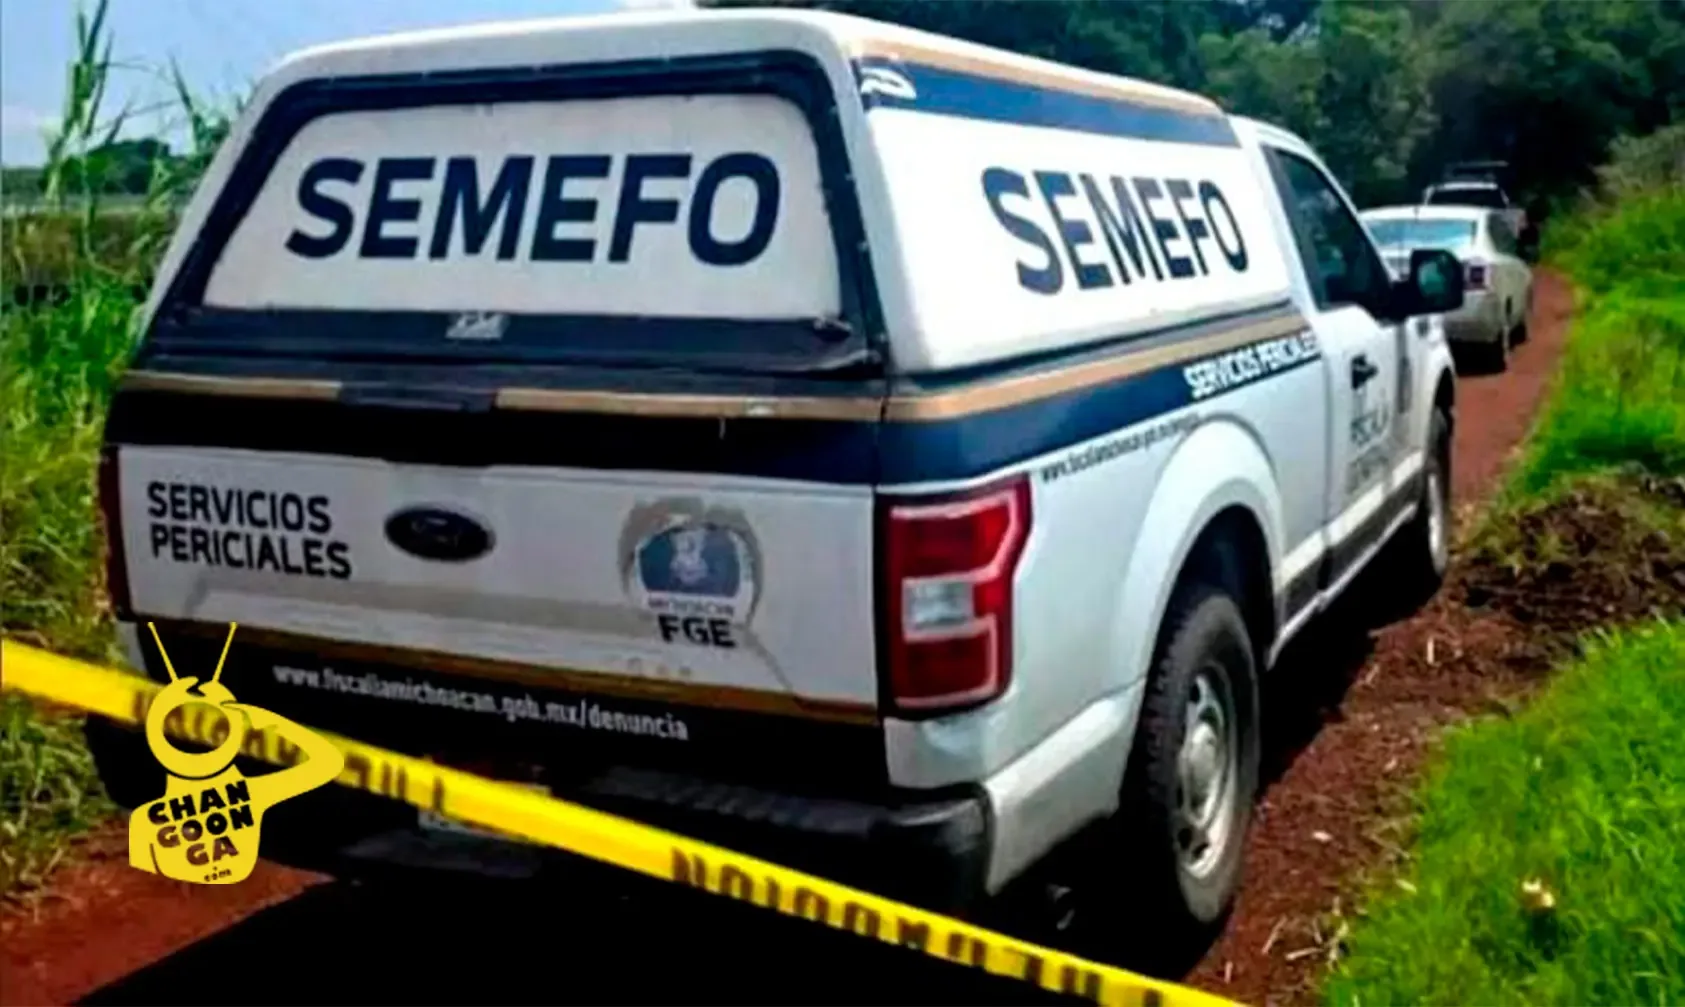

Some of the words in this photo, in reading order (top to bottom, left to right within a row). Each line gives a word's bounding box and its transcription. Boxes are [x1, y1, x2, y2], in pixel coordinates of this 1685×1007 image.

[285, 152, 780, 267] SEMEFO
[981, 166, 1249, 295] SEMEFO
[147, 481, 332, 534] SERVICIOS
[150, 523, 352, 580] PERICIALES
[658, 613, 736, 648] FGE
[272, 664, 689, 741] www.fiscaliamichoacan.gob.mx/denuncia
